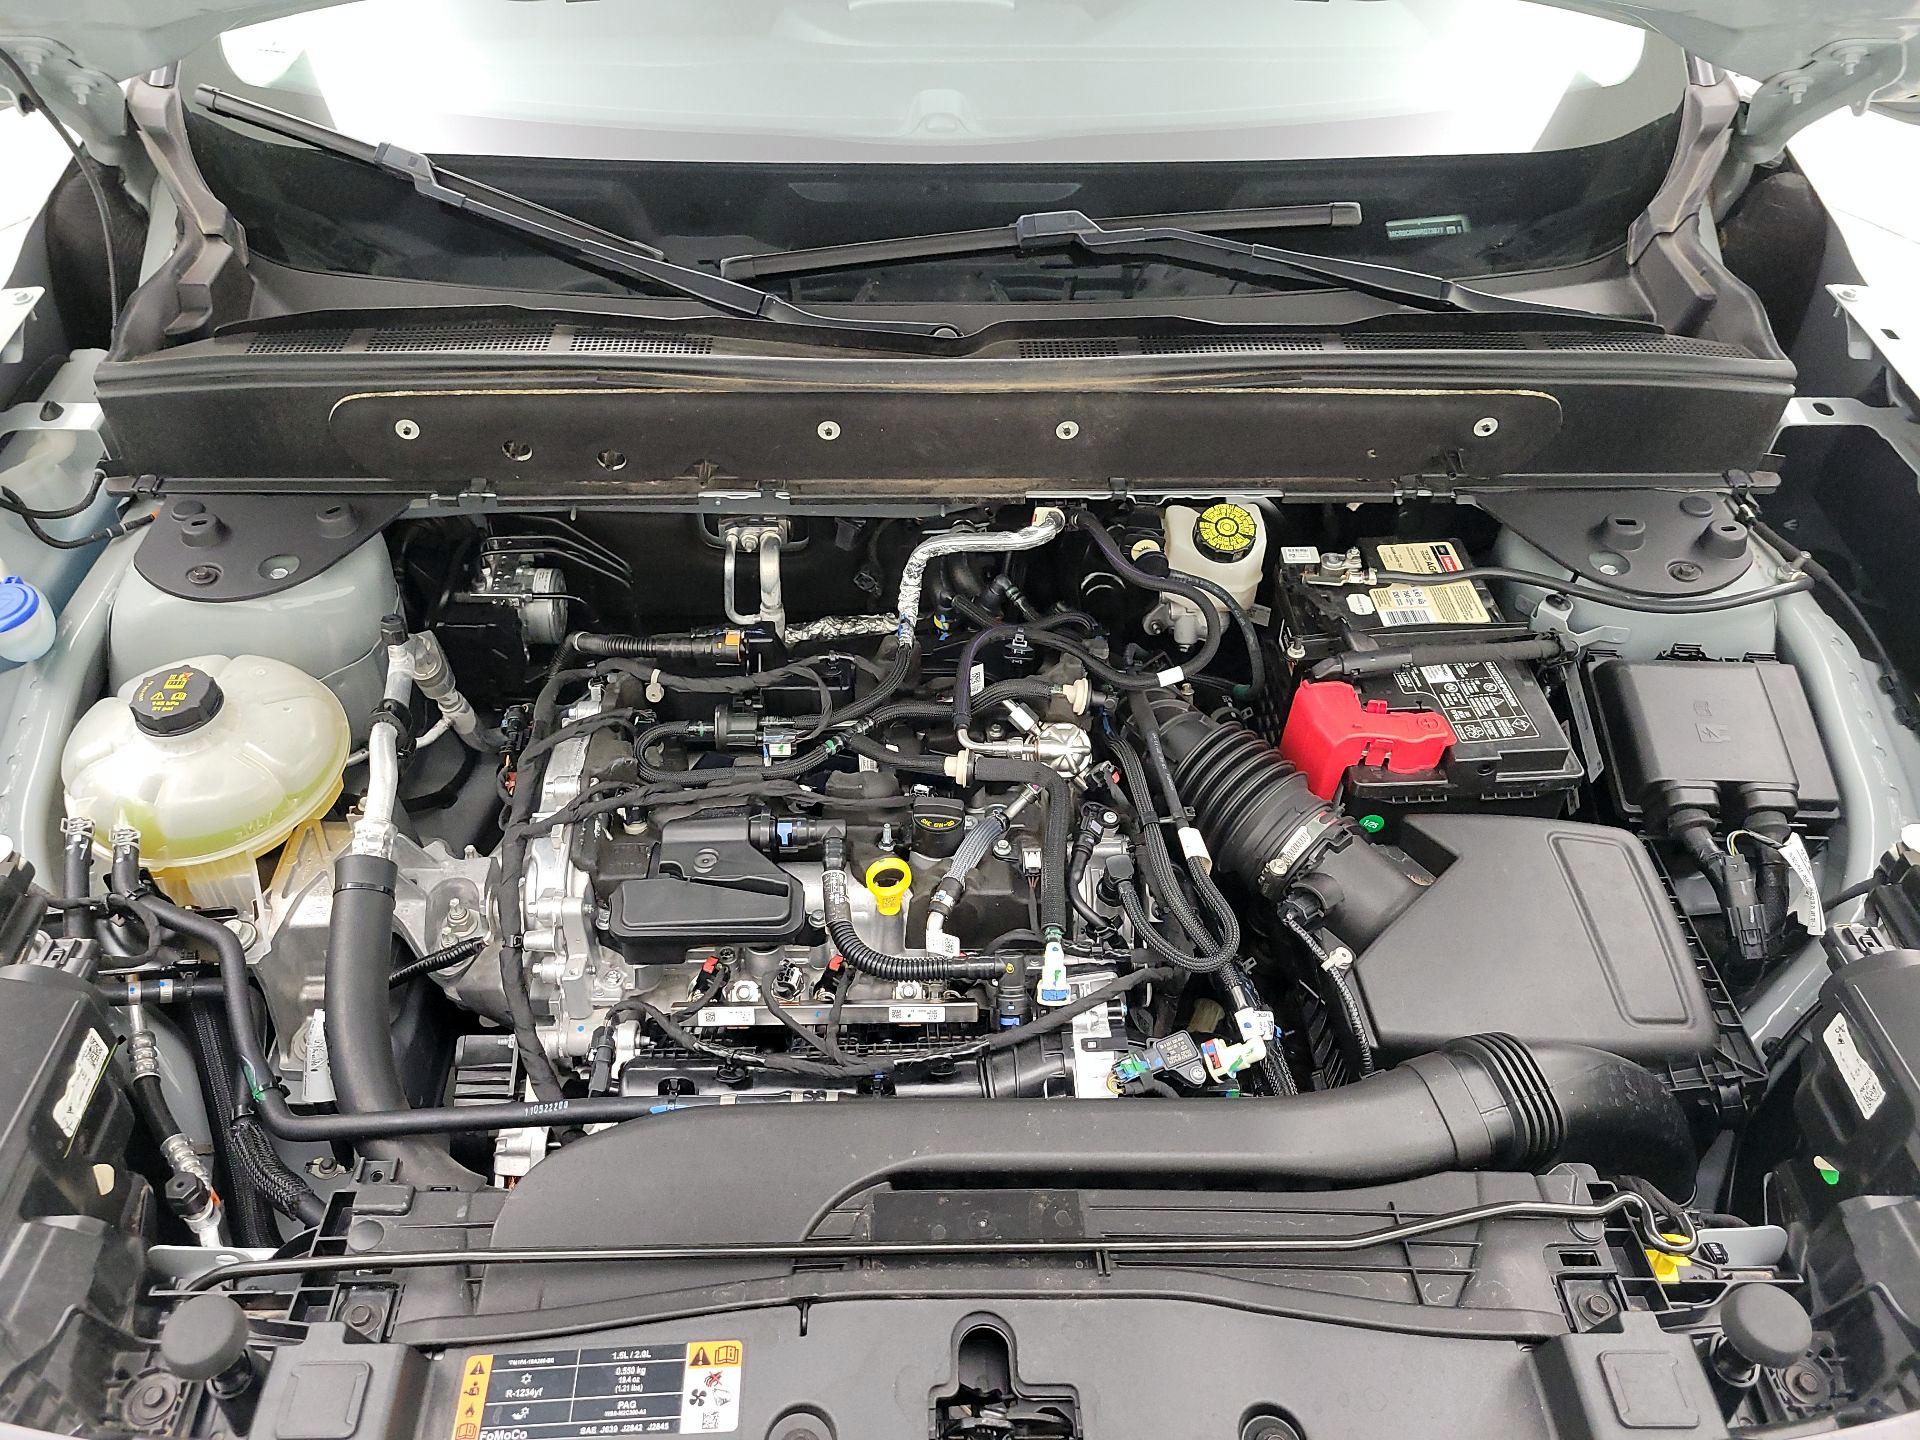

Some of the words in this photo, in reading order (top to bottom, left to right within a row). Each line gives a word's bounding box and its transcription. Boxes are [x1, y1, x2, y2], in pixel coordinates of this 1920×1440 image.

[636, 1366, 646, 1376] kg
[505, 1387, 544, 1398] R-1234yf
[617, 1400, 637, 1409] PAG
[479, 1429, 528, 1440] FoMoCo
